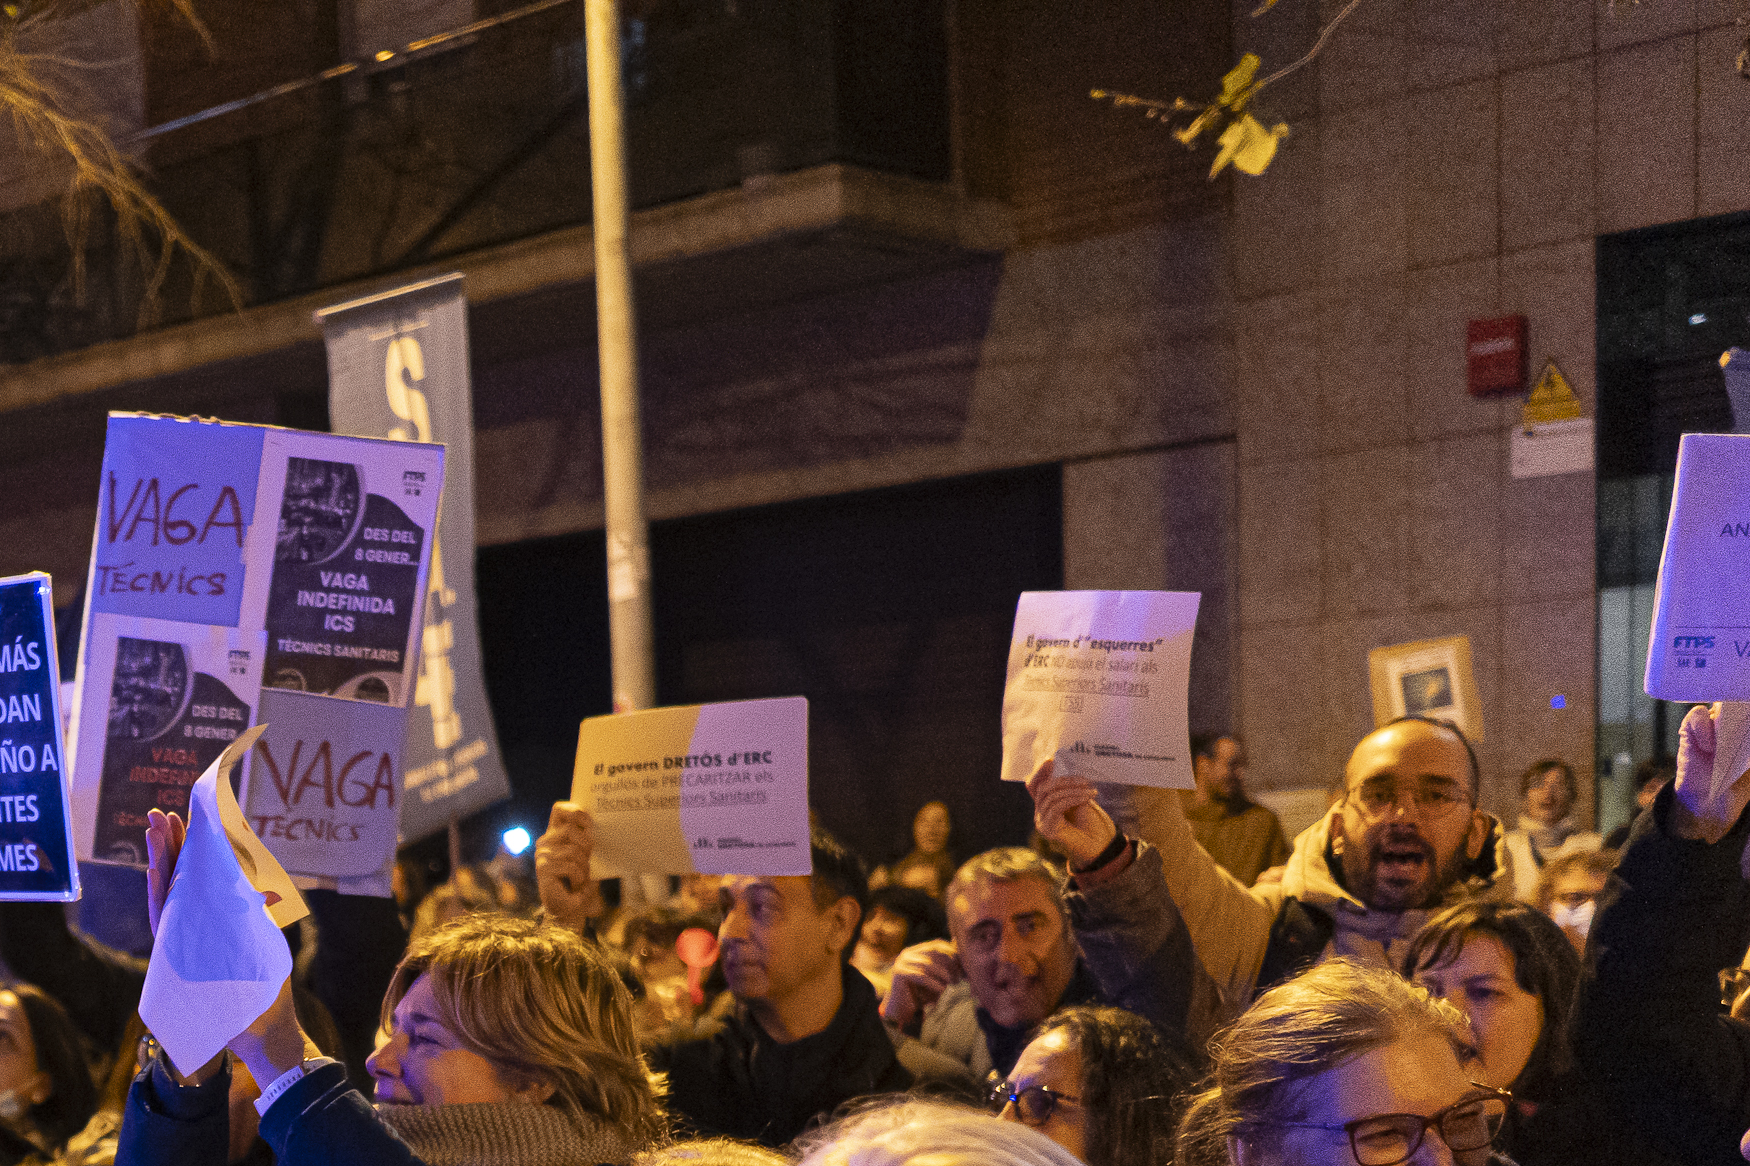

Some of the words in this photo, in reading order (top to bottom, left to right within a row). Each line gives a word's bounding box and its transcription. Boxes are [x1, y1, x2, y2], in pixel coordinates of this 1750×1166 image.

[108, 471, 243, 548] VAGA
[320, 571, 369, 591] VAGA
[297, 590, 395, 615] INDEFINIDA
[324, 614, 355, 632] ICS
[1674, 636, 1715, 649] FTPS
[41, 744, 58, 771] A
[152, 747, 198, 766] VAGA
[257, 740, 395, 810] VAGA
[607, 761, 659, 777] govern
